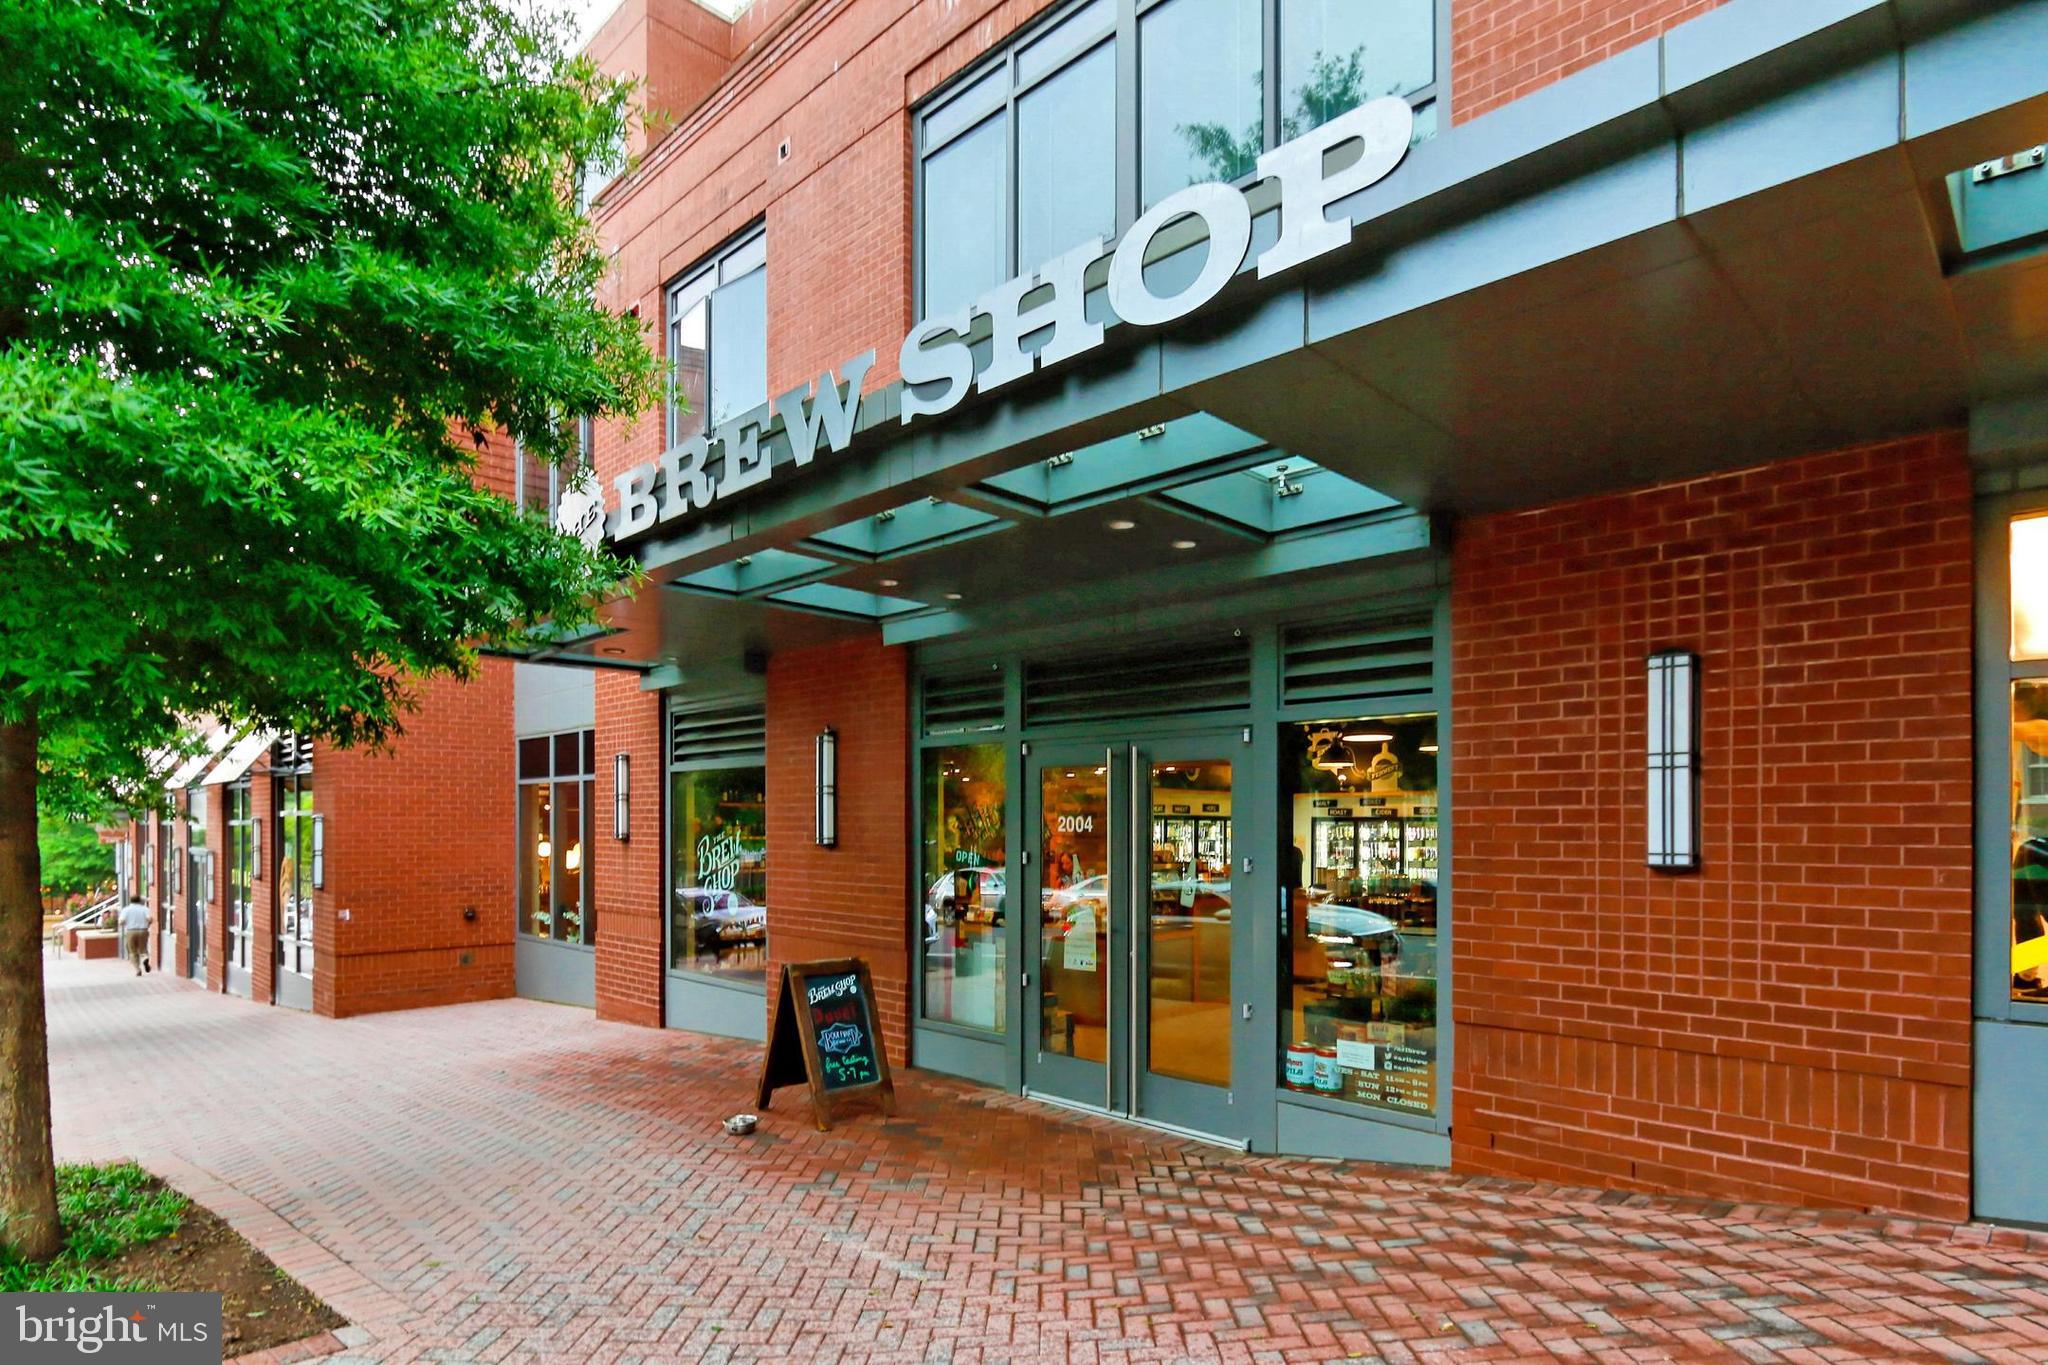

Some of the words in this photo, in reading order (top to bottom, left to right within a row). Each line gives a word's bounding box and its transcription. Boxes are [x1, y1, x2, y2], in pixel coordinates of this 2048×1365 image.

[614, 348, 878, 541] BREW
[900, 95, 1414, 427] SHOP
[1057, 815, 1093, 833] 2004
[697, 829, 742, 880] BREW
[955, 849, 981, 866] OPEN
[807, 984, 836, 1005] BREW
[1360, 1070, 1381, 1080] SAT
[1357, 1080, 1381, 1091] SUN
[1356, 1090, 1381, 1101] MON
[1386, 1096, 1428, 1110] CLOSED
